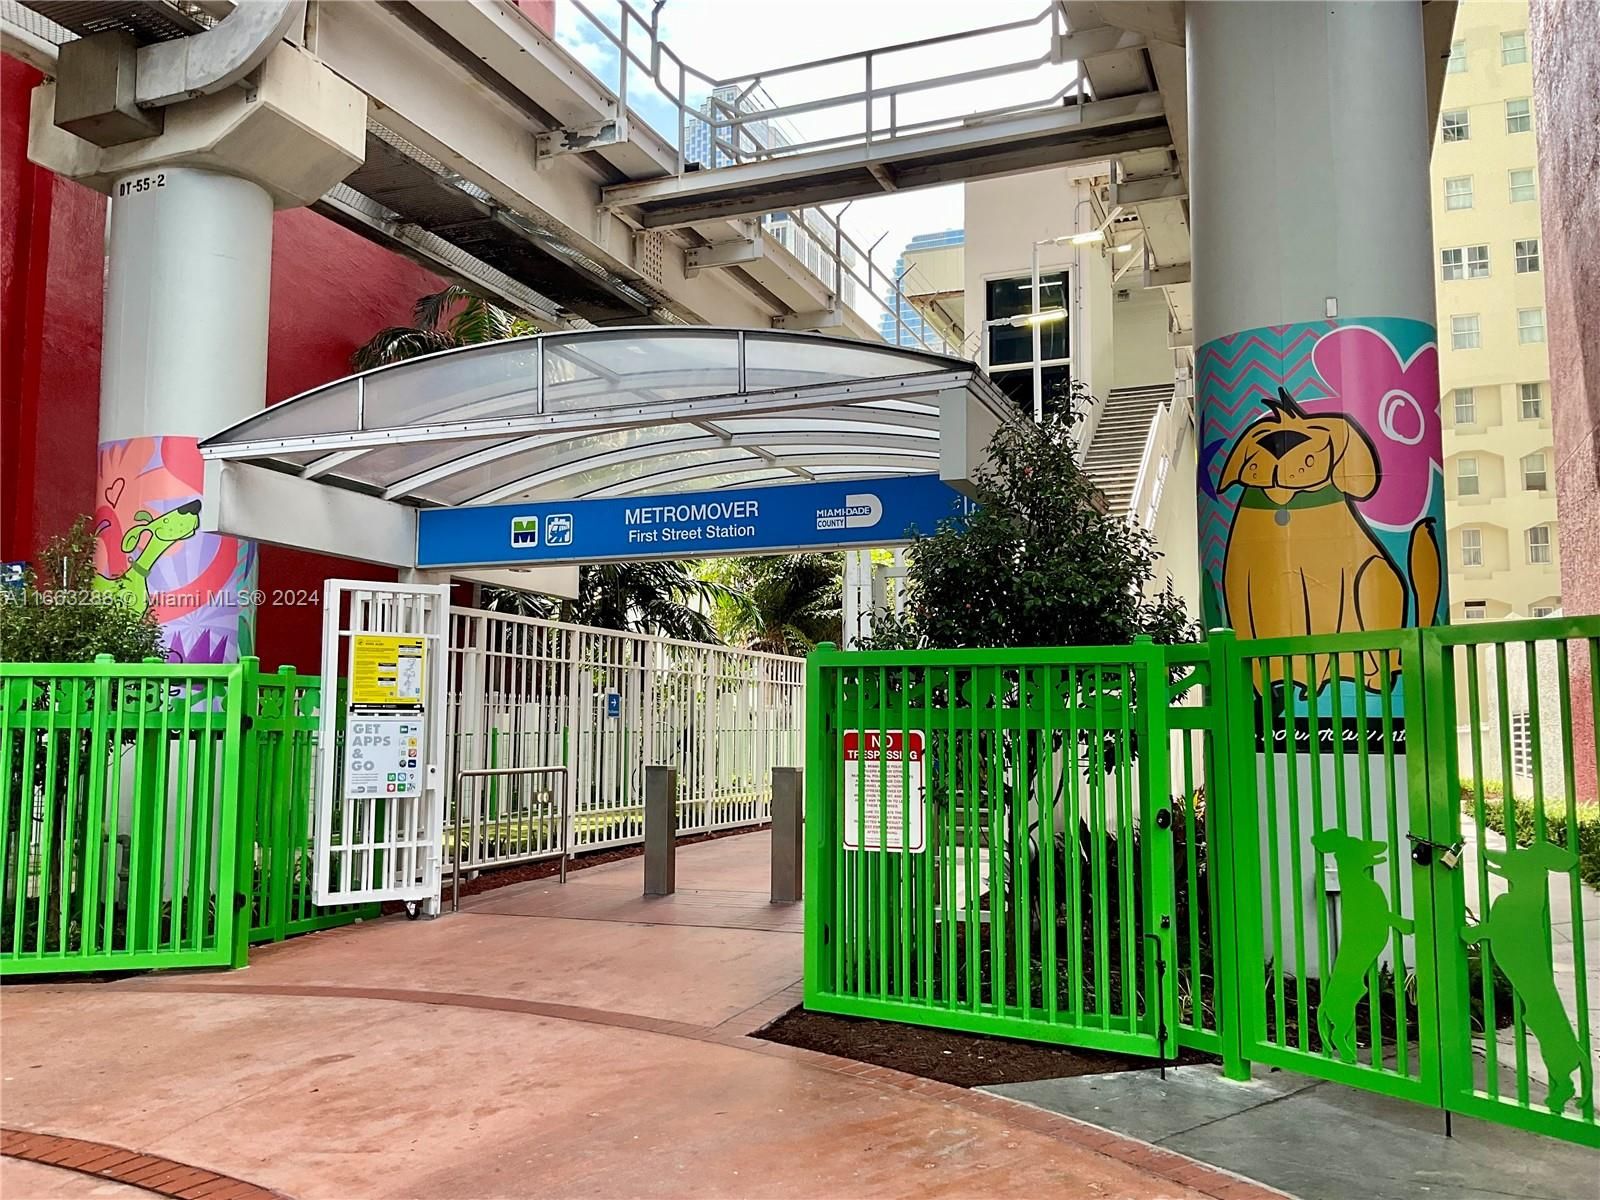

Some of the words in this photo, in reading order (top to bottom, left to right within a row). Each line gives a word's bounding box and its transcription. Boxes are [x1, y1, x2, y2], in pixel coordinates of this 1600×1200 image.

[119, 173, 166, 197] DT-55-2
[625, 500, 759, 525] METROMOVER
[817, 518, 844, 529] COUNTY
[628, 529, 658, 543] First
[661, 526, 702, 542] Street
[705, 524, 755, 539] Station
[353, 723, 381, 734] GET
[352, 736, 391, 747] APPS
[352, 748, 363, 759] &
[847, 749, 918, 760] TESPSSIG
[351, 760, 375, 771] GO
